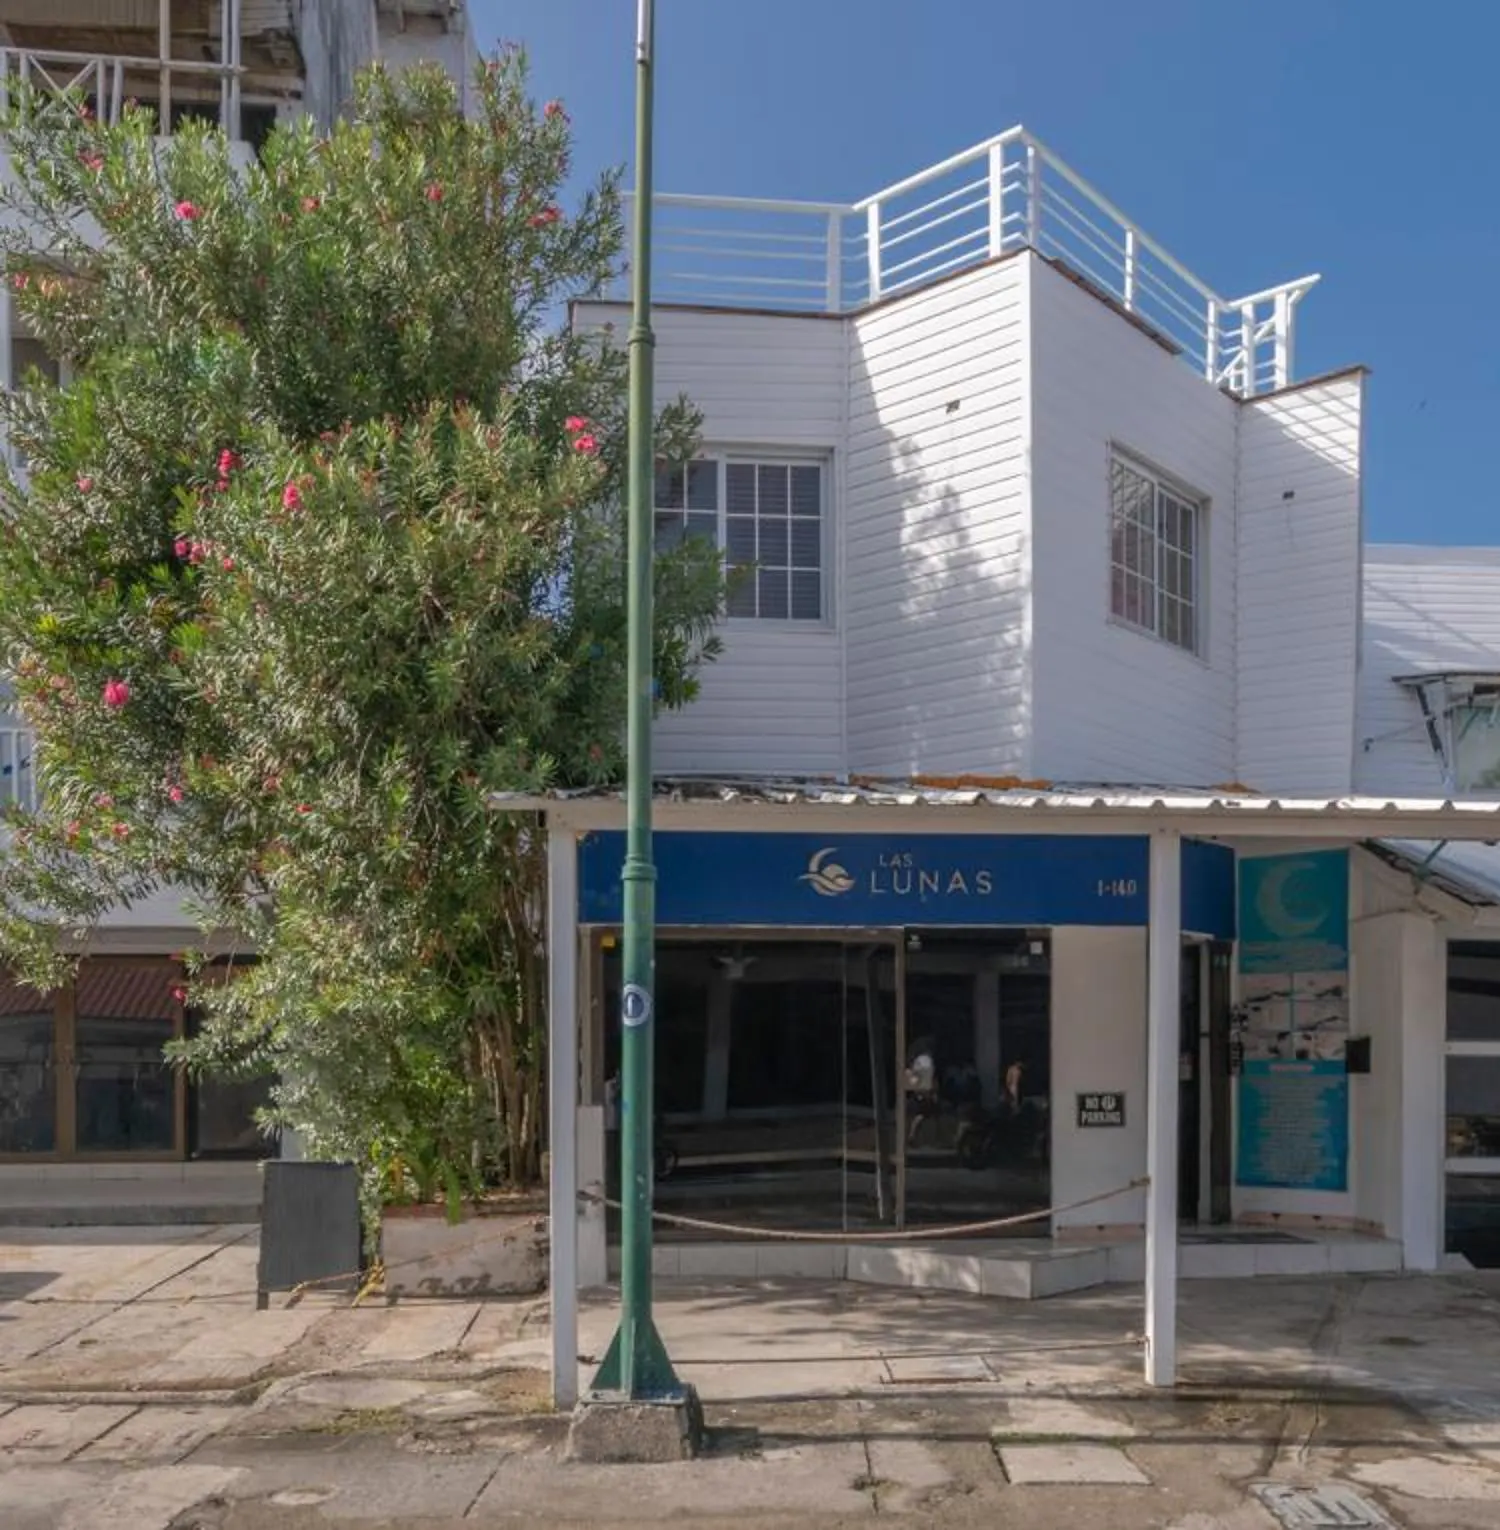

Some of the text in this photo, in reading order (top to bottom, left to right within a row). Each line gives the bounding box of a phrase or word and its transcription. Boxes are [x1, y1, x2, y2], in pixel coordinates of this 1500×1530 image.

[879, 854, 913, 867] LAS
[871, 868, 992, 895] LUNAS
[1085, 1097, 1099, 1109] NO
